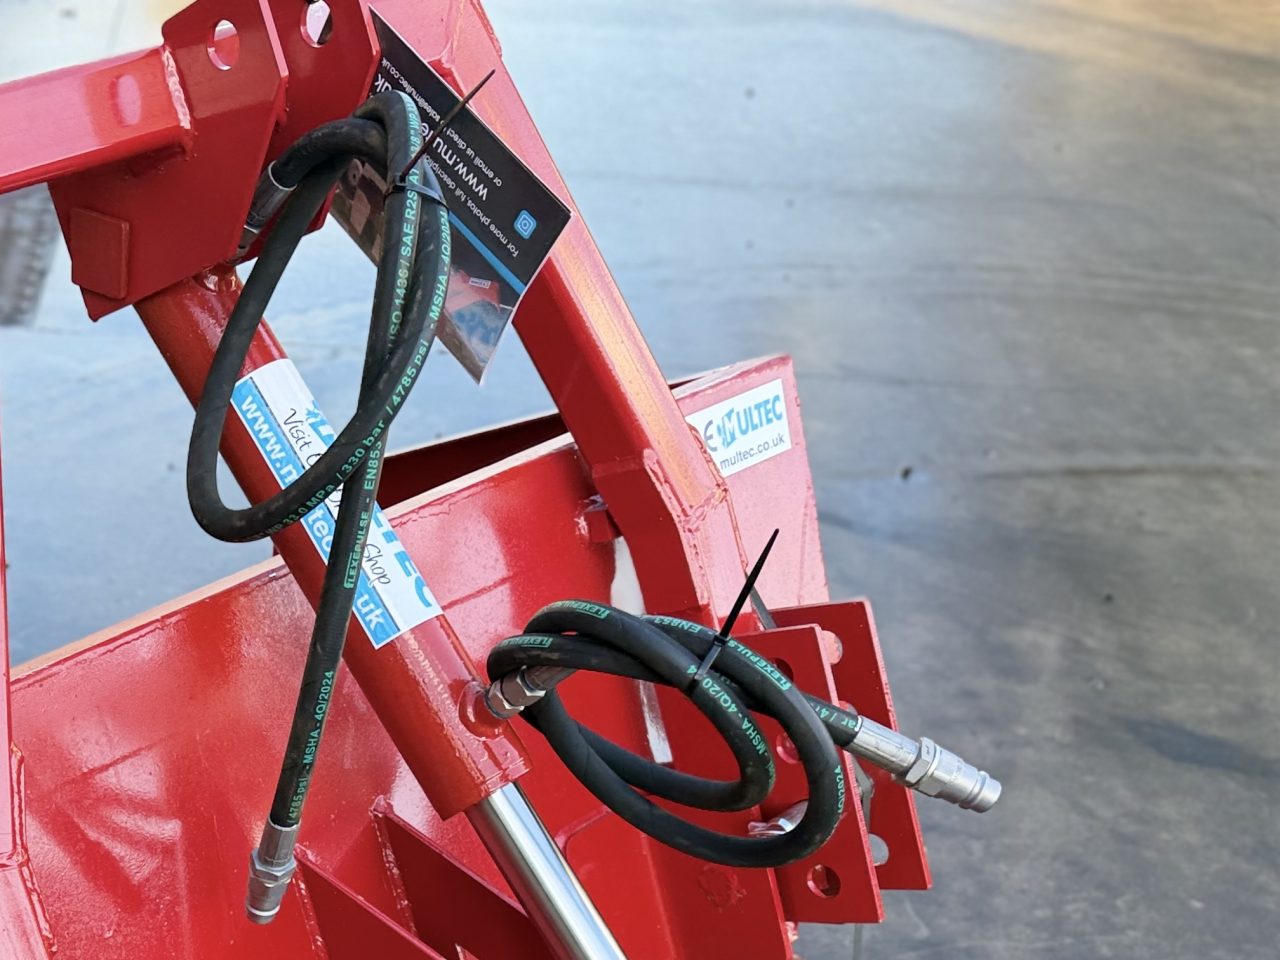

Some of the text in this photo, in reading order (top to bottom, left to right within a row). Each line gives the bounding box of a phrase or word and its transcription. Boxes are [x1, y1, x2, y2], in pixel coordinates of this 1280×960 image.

[465, 147, 475, 157] us
[473, 156, 494, 178] email
[401, 223, 415, 257] SAE
[489, 224, 508, 244] more
[507, 242, 519, 257] For
[341, 449, 365, 473] 330
[363, 419, 385, 447] bar
[391, 367, 417, 407] 4785
[429, 275, 448, 320] MSHA
[284, 408, 391, 588] Visit Shop
[727, 638, 793, 692] FLEXEPULS
[303, 729, 320, 765] MSHA
[314, 670, 334, 721] 4Q/2024
